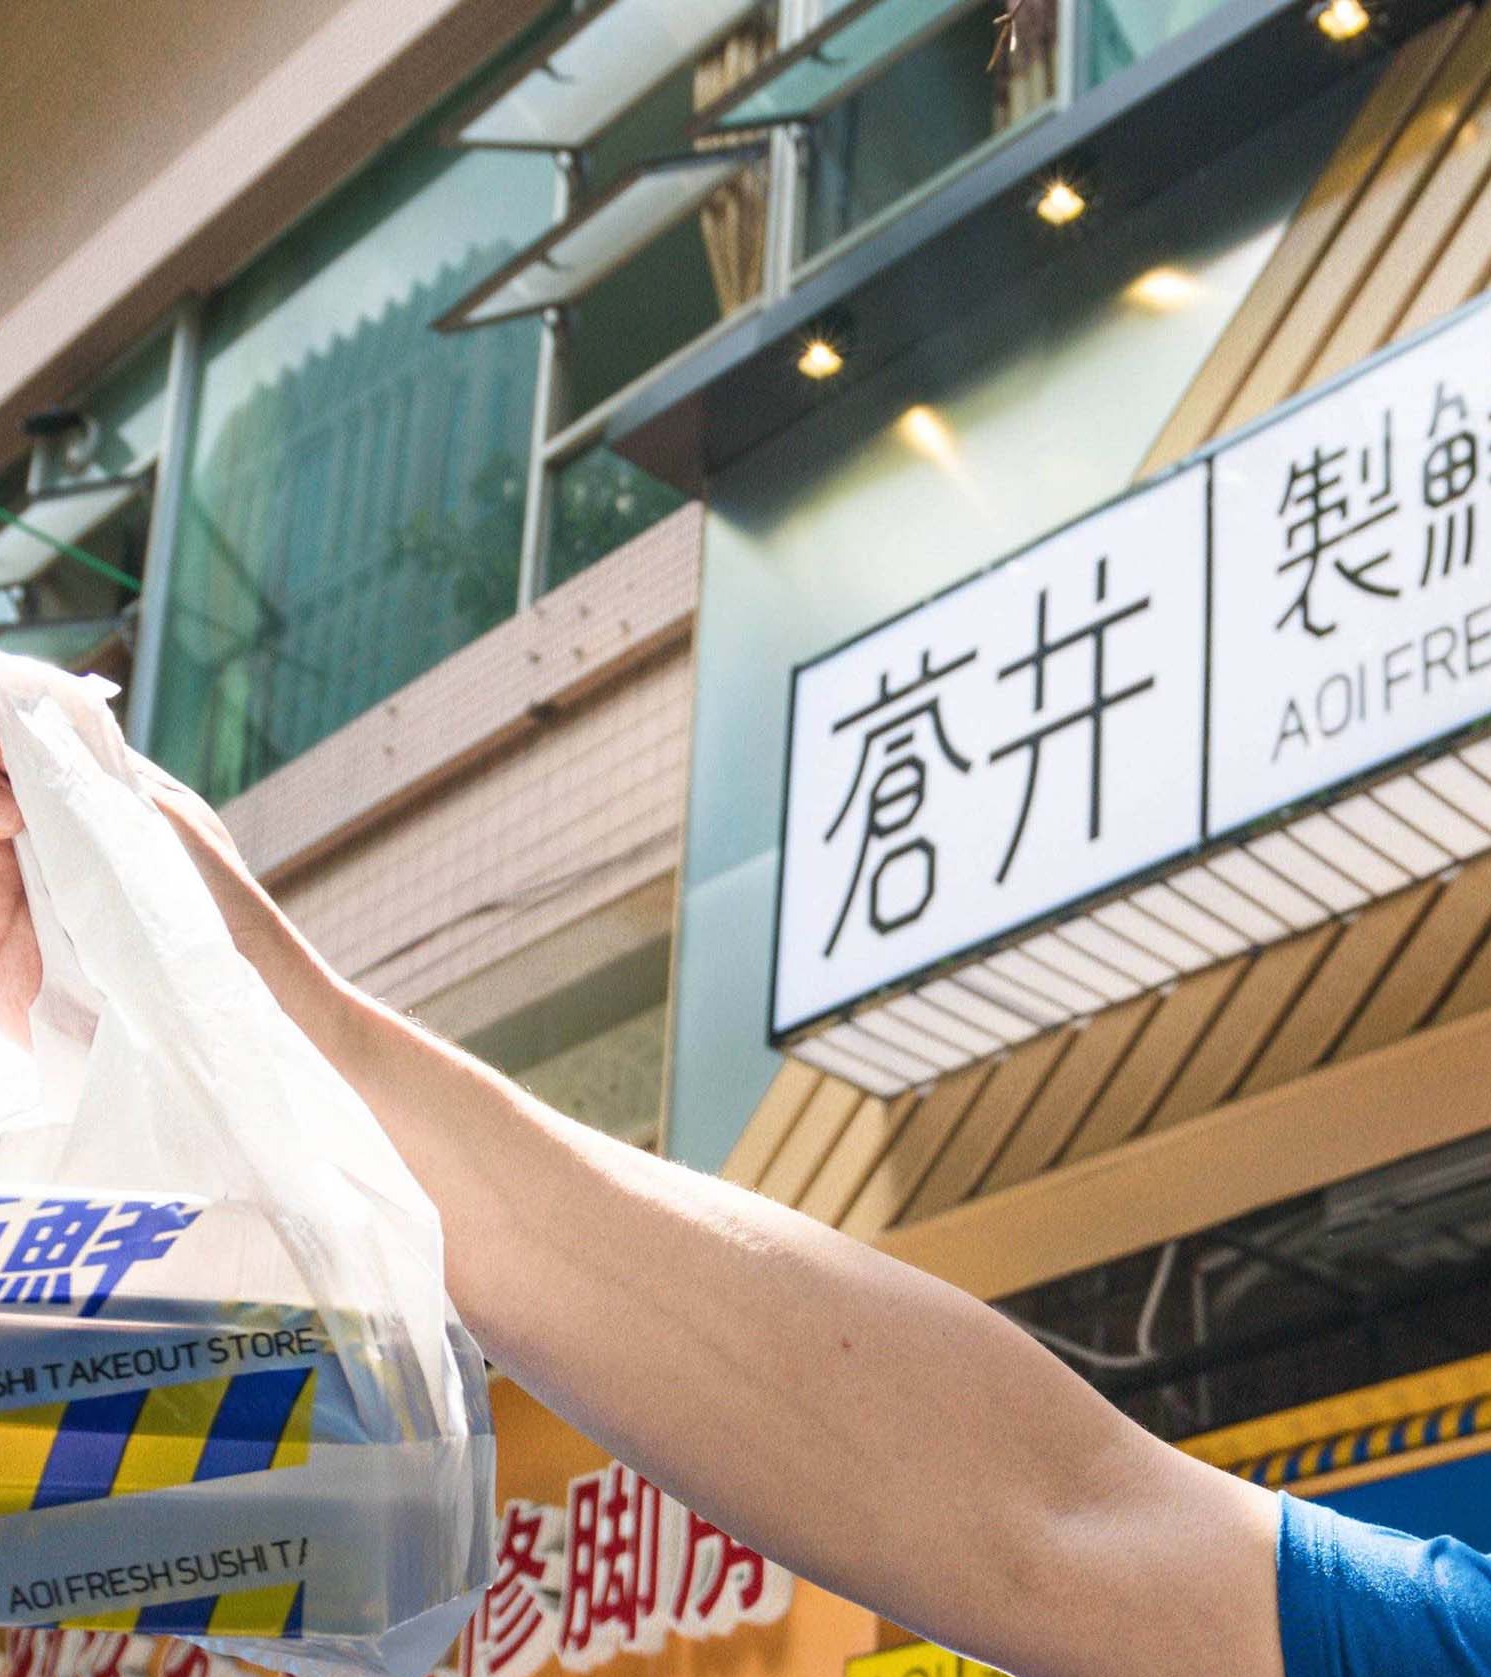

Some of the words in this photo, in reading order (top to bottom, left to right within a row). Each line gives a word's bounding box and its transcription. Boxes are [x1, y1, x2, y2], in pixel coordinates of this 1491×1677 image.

[1271, 662, 1366, 763] AOI
[823, 556, 1155, 957] 蒼井
[42, 1341, 200, 1389] TAKEOUT
[207, 1328, 318, 1365] STORE
[9, 1580, 63, 1613] AOI
[65, 1561, 174, 1604] FRESH
[175, 1543, 268, 1585] SUSHI
